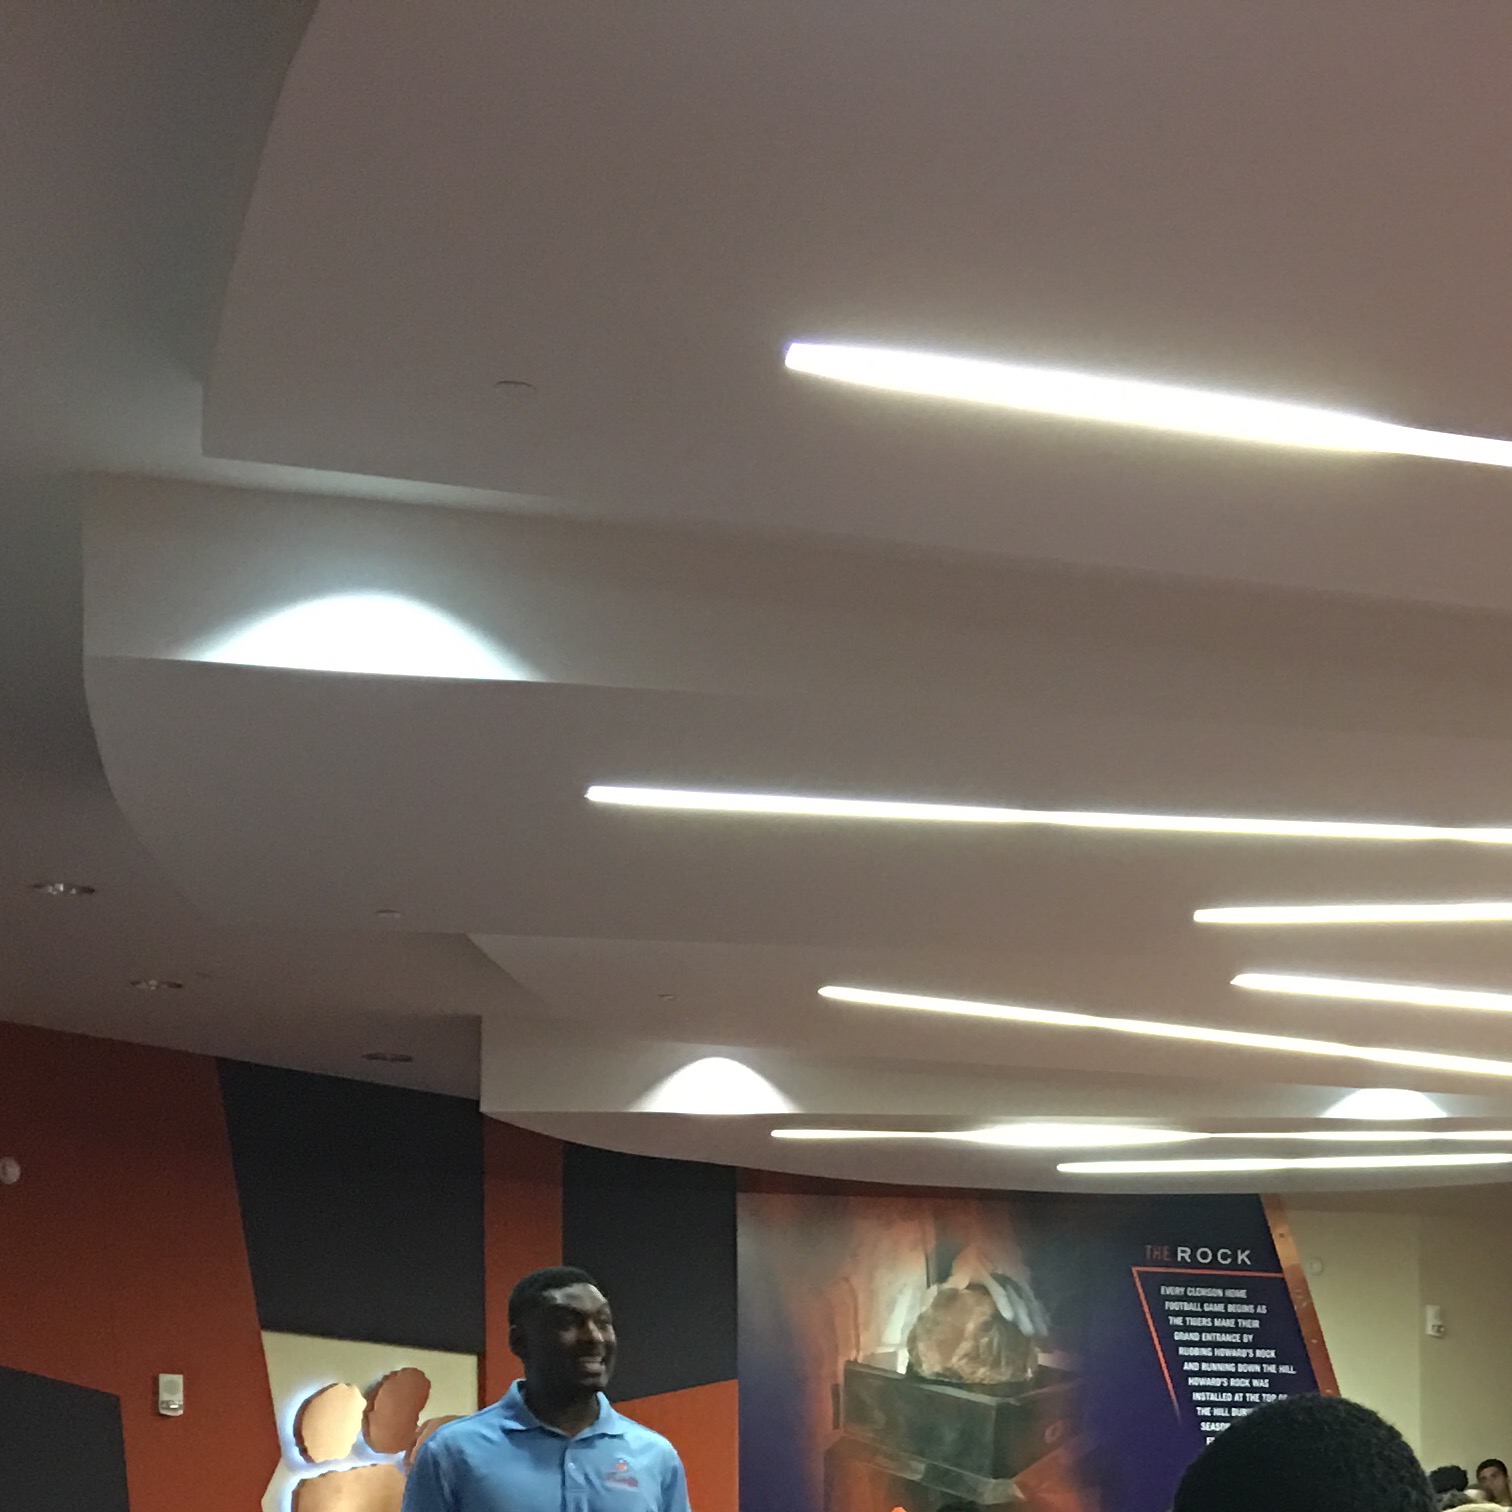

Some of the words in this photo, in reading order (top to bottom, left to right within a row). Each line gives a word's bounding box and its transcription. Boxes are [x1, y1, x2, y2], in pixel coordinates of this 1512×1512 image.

[1144, 1244, 1170, 1260] THE
[1177, 1246, 1252, 1265] ROCK
[1160, 1286, 1185, 1296] EVERY
[1187, 1287, 1224, 1297] CLEMSON
[1225, 1288, 1247, 1298] HOME
[1165, 1301, 1202, 1311] FOOTBALL
[1203, 1302, 1225, 1312] GAME
[1227, 1303, 1254, 1313] BEGINS
[1256, 1304, 1267, 1314] AS
[1168, 1315, 1183, 1325] THE
[1185, 1316, 1212, 1326] TIGERS
[1214, 1317, 1235, 1327] MAKE
[1237, 1318, 1260, 1328] THEIR
[1174, 1331, 1200, 1341] GRAND
[1202, 1332, 1241, 1342] ENTRANCE
[1242, 1333, 1254, 1343] BY
[1178, 1346, 1212, 1356] RUBBING
[1214, 1347, 1254, 1358] HOWARD'S
[1256, 1348, 1276, 1358] ROCK
[1183, 1361, 1200, 1371] AND
[1201, 1362, 1236, 1372] RUNNING
[1237, 1363, 1260, 1373] DOWN
[1262, 1363, 1277, 1373] THE
[1188, 1377, 1228, 1387] HOWARD'S
[1230, 1377, 1251, 1387] ROCK
[1252, 1378, 1269, 1388] WAS
[1192, 1391, 1232, 1401] INSTALLED
[1234, 1392, 1244, 1402] AT
[1245, 1393, 1260, 1402] THE
[1262, 1393, 1277, 1402] TOP
[1196, 1406, 1211, 1416] THE
[1213, 1407, 1230, 1417] HILL
[1231, 1407, 1254, 1417] DUR
